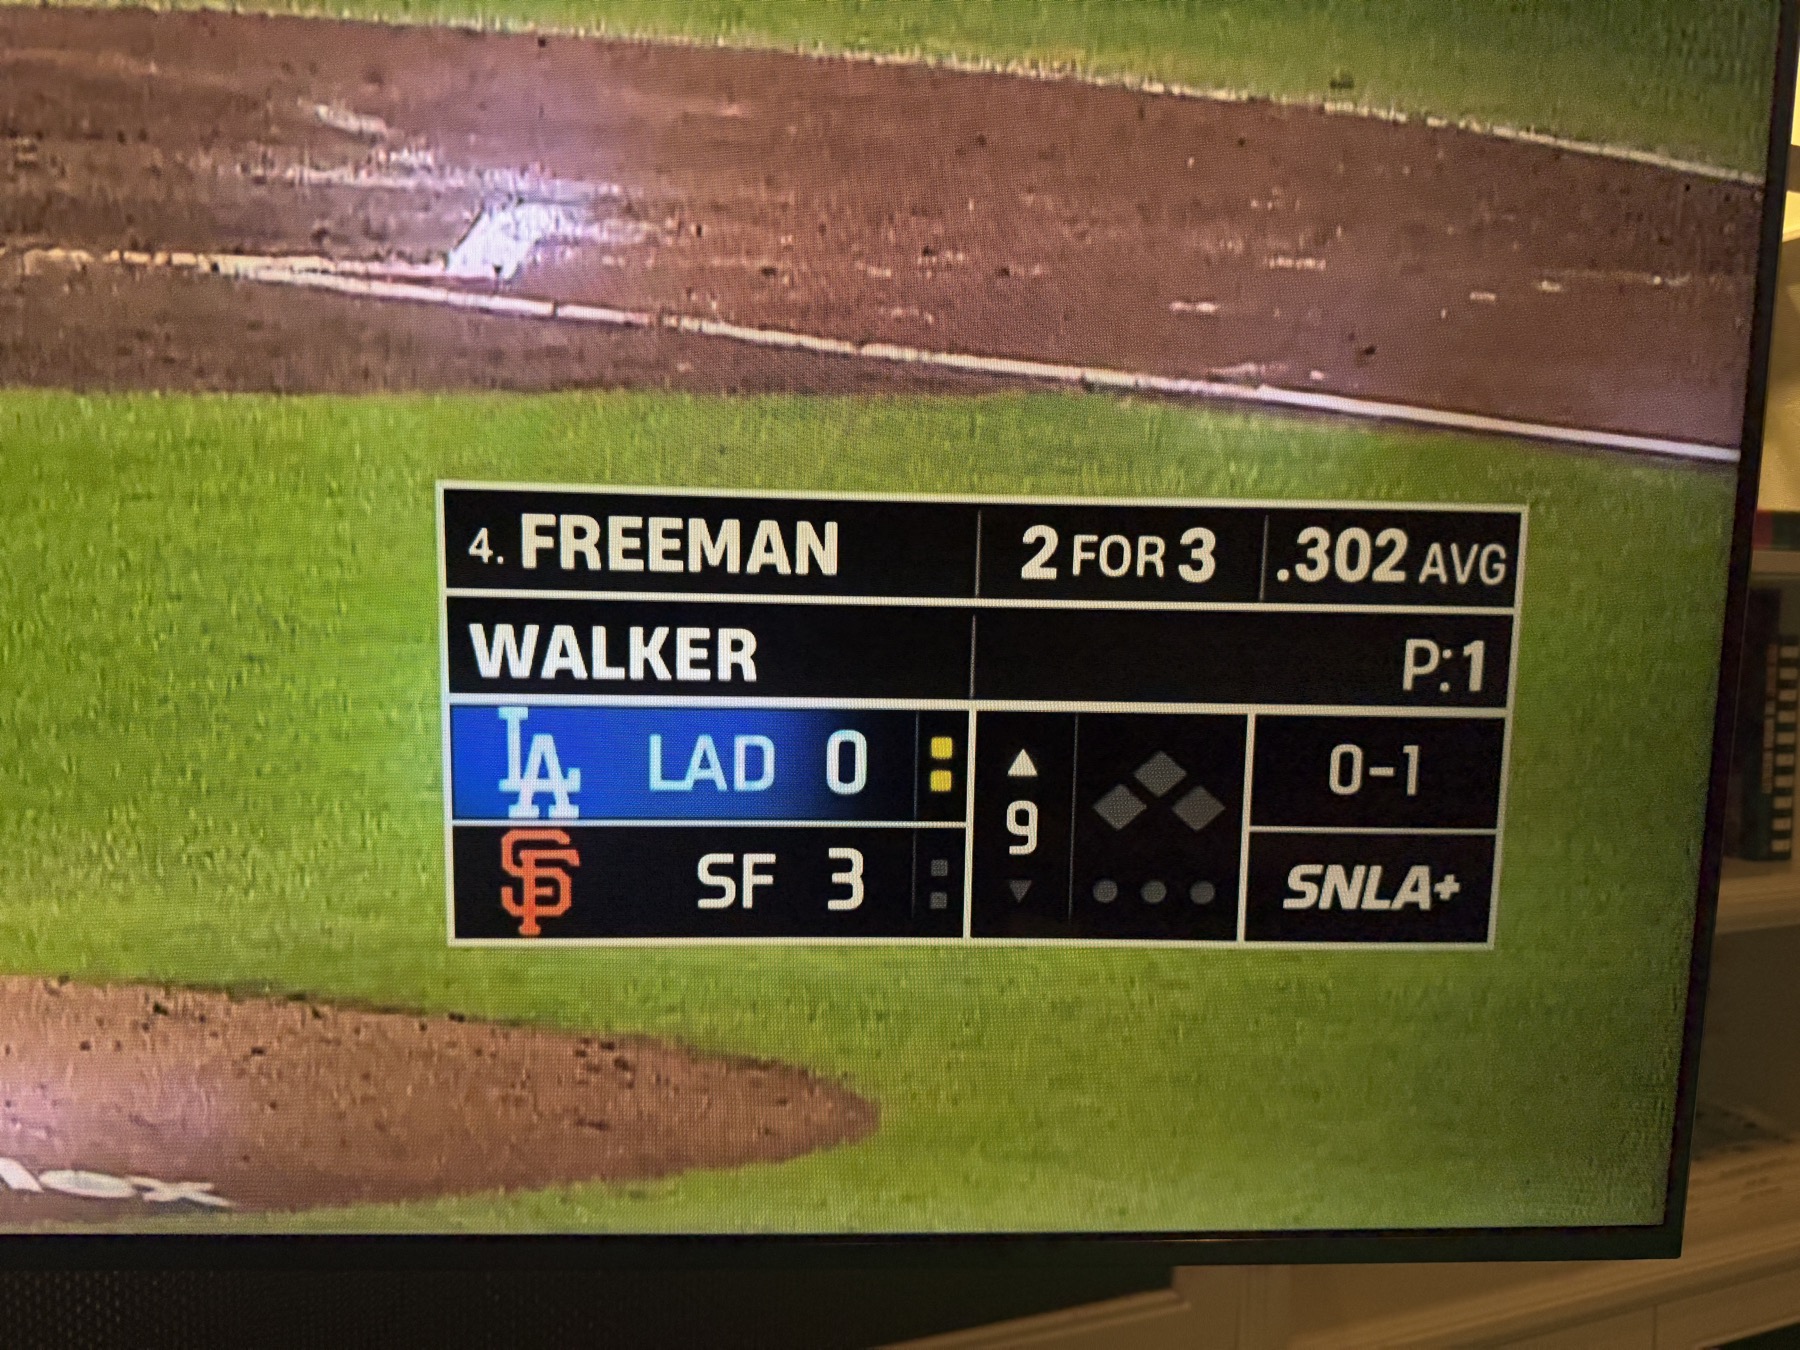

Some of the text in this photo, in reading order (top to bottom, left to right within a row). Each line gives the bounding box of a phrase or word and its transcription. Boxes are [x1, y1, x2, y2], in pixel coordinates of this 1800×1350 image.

[468, 513, 839, 576] 4. FREEMAN
[1020, 524, 1217, 583] 2 FOR 3
[1276, 526, 1507, 586] .302 AVG
[468, 623, 758, 682] WALKER
[1402, 638, 1486, 692] P:1
[498, 706, 581, 819] LA
[648, 729, 867, 795] LAD 0
[1328, 743, 1420, 796] 0-1
[1005, 799, 1038, 856] 9
[697, 847, 865, 911] SF 3
[1282, 864, 1460, 910] SNLA+
